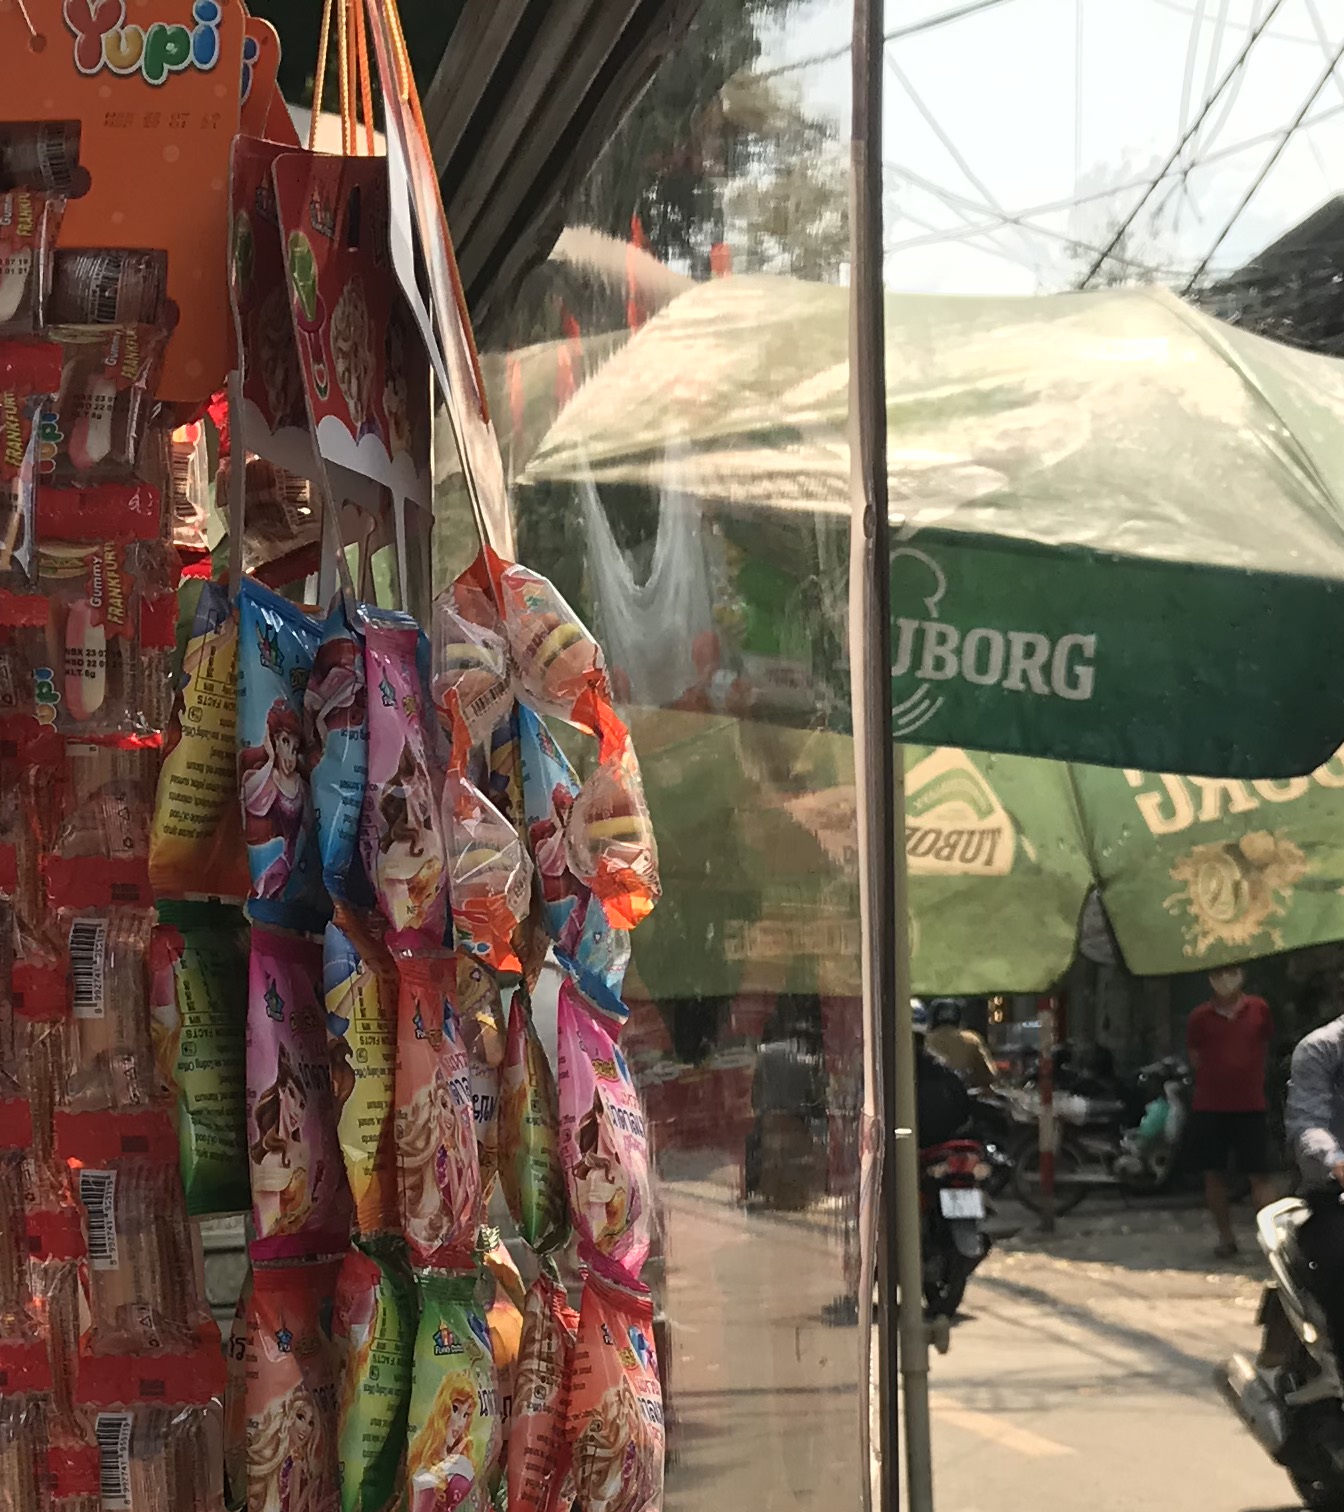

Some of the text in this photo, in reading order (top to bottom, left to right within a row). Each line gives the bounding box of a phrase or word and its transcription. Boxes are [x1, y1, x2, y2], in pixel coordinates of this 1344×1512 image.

[63, 0, 222, 86] Yupi
[90, 556, 103, 607] Gummy
[891, 617, 1098, 700] UBORG
[107, 1221, 115, 1252] 992741
[120, 1423, 130, 1452] 955119
[121, 1462, 129, 1493] 992741
